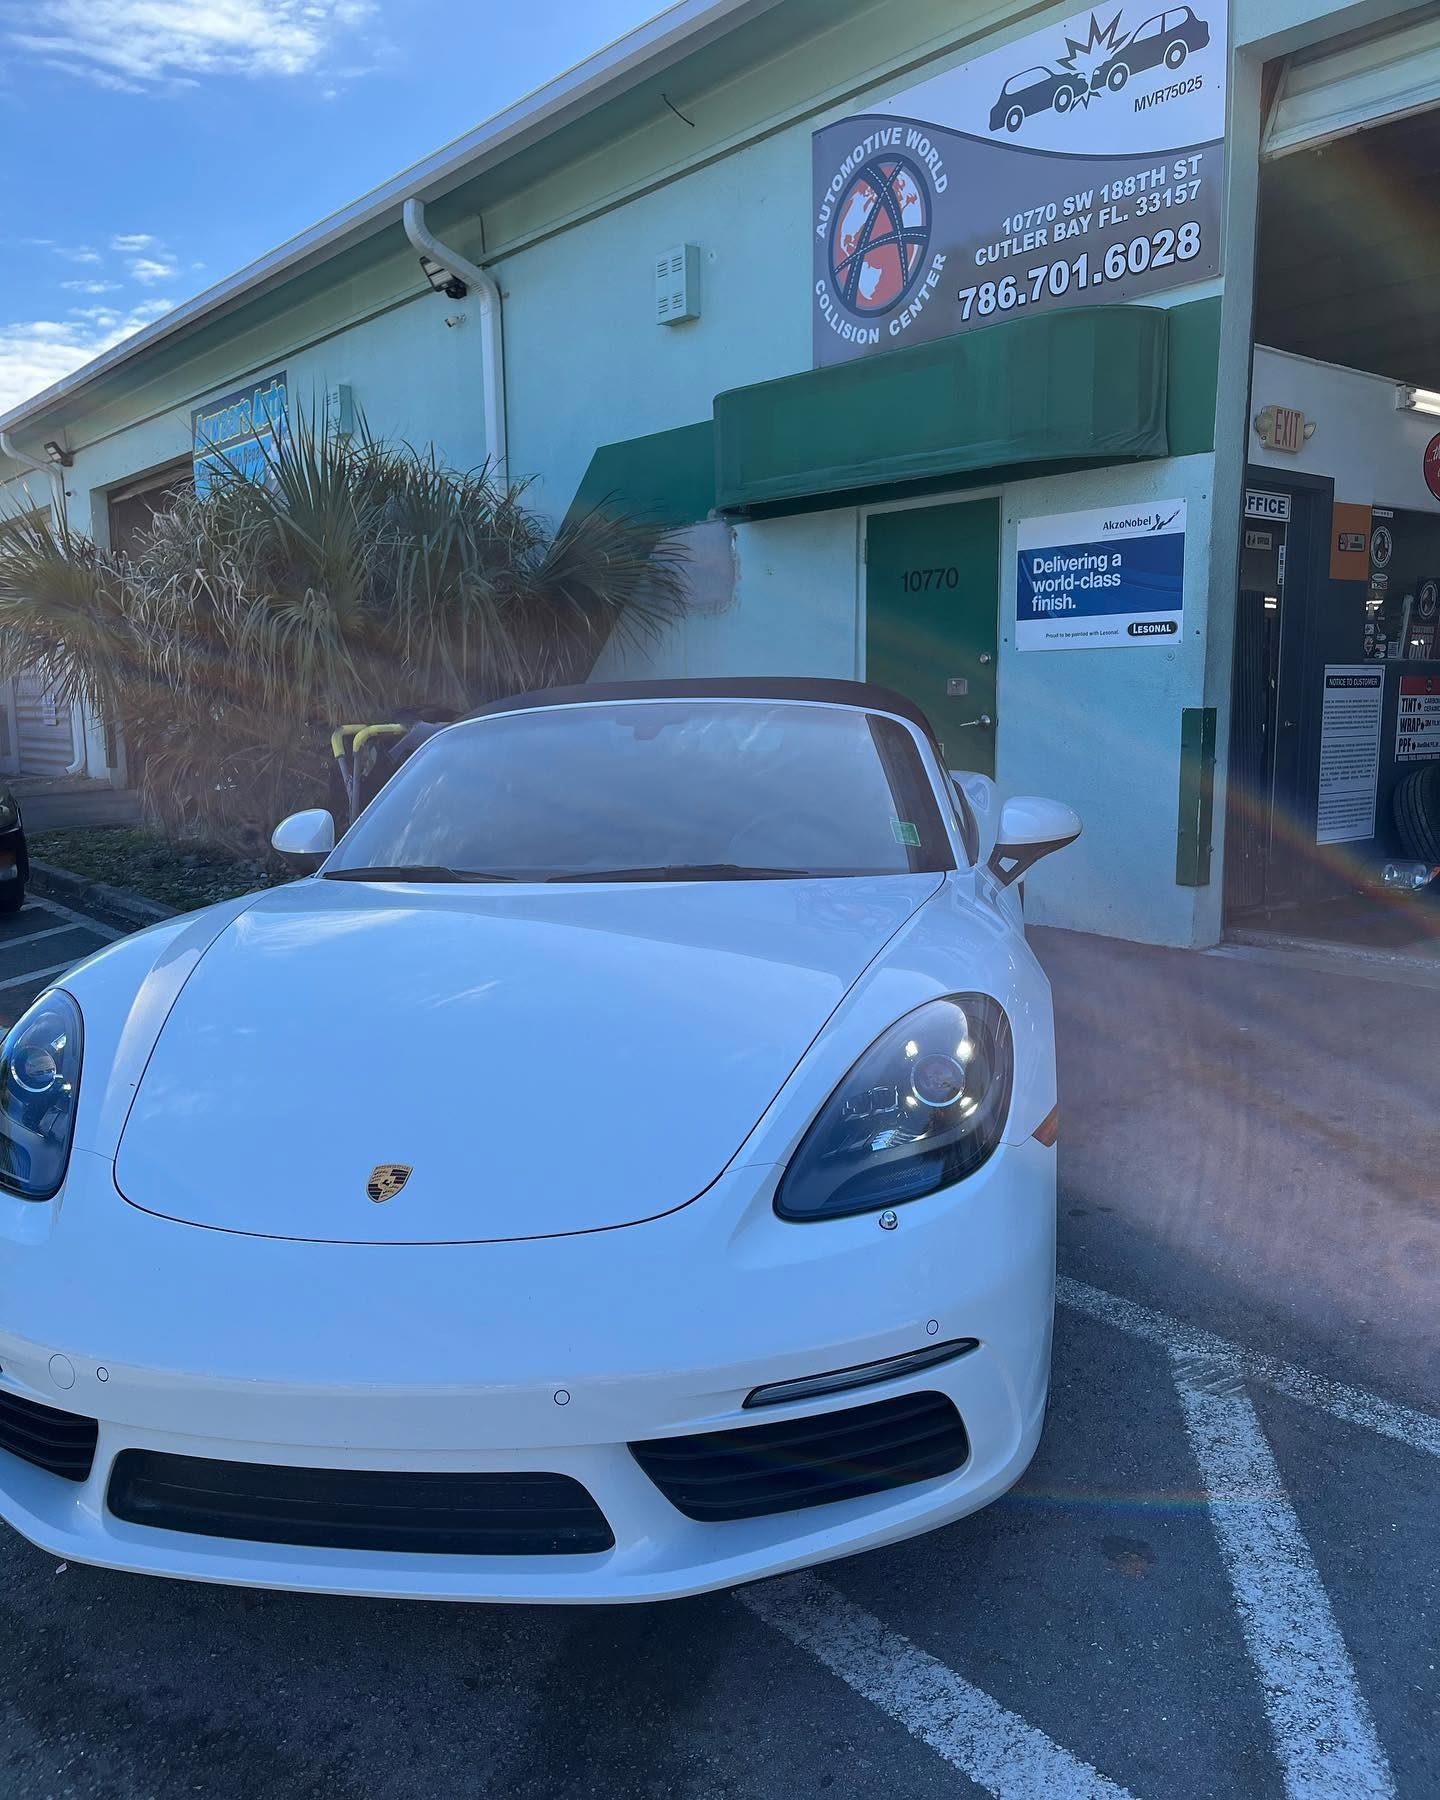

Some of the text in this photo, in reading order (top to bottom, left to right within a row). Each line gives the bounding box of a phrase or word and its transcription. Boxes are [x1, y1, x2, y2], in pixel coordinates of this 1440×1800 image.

[1134, 76, 1203, 113] MVR75025
[815, 127, 948, 239] AUTOMOTIVE WORLD
[1002, 154, 1203, 236] 10770 SW 188TH ST
[975, 179, 1202, 266] CUTLER BAY FL. 33157
[958, 221, 1202, 321] 786.701.6028
[815, 253, 947, 345] COLLISION CENTER
[1274, 408, 1300, 449] EXIT
[1247, 495, 1286, 515] FFICE
[1102, 515, 1152, 531] AkzoNobel
[1032, 553, 1122, 575] Delivering a
[900, 566, 959, 593] 10770
[1032, 572, 1121, 593] world-class
[1031, 593, 1076, 612] finish.
[1329, 677, 1378, 686] NOTICE TO CUSTOMER
[1402, 697, 1417, 713] TINT
[1400, 718, 1421, 733] WRAP
[1399, 737, 1411, 752] PPF
